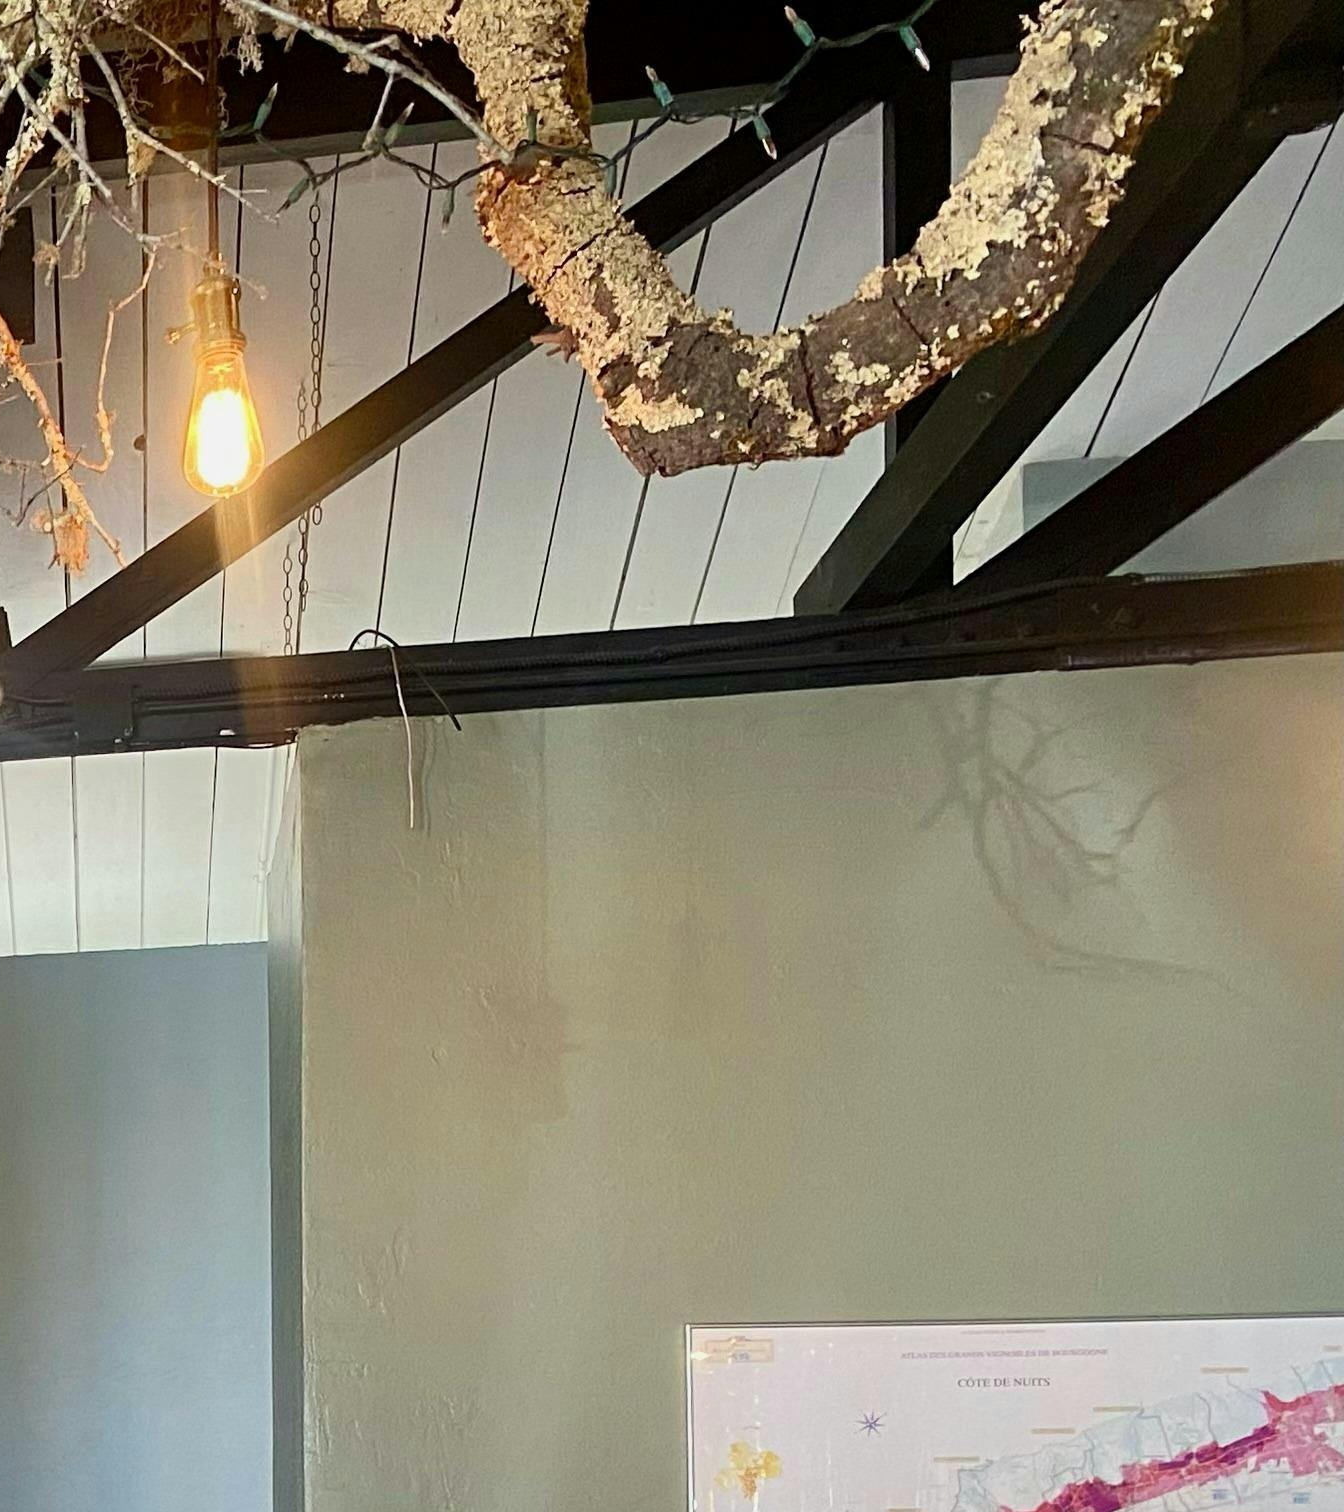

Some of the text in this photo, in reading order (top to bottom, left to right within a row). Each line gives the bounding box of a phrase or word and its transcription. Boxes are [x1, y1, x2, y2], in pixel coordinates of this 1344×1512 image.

[957, 1376, 1051, 1388] CÔTE DE NUITS
